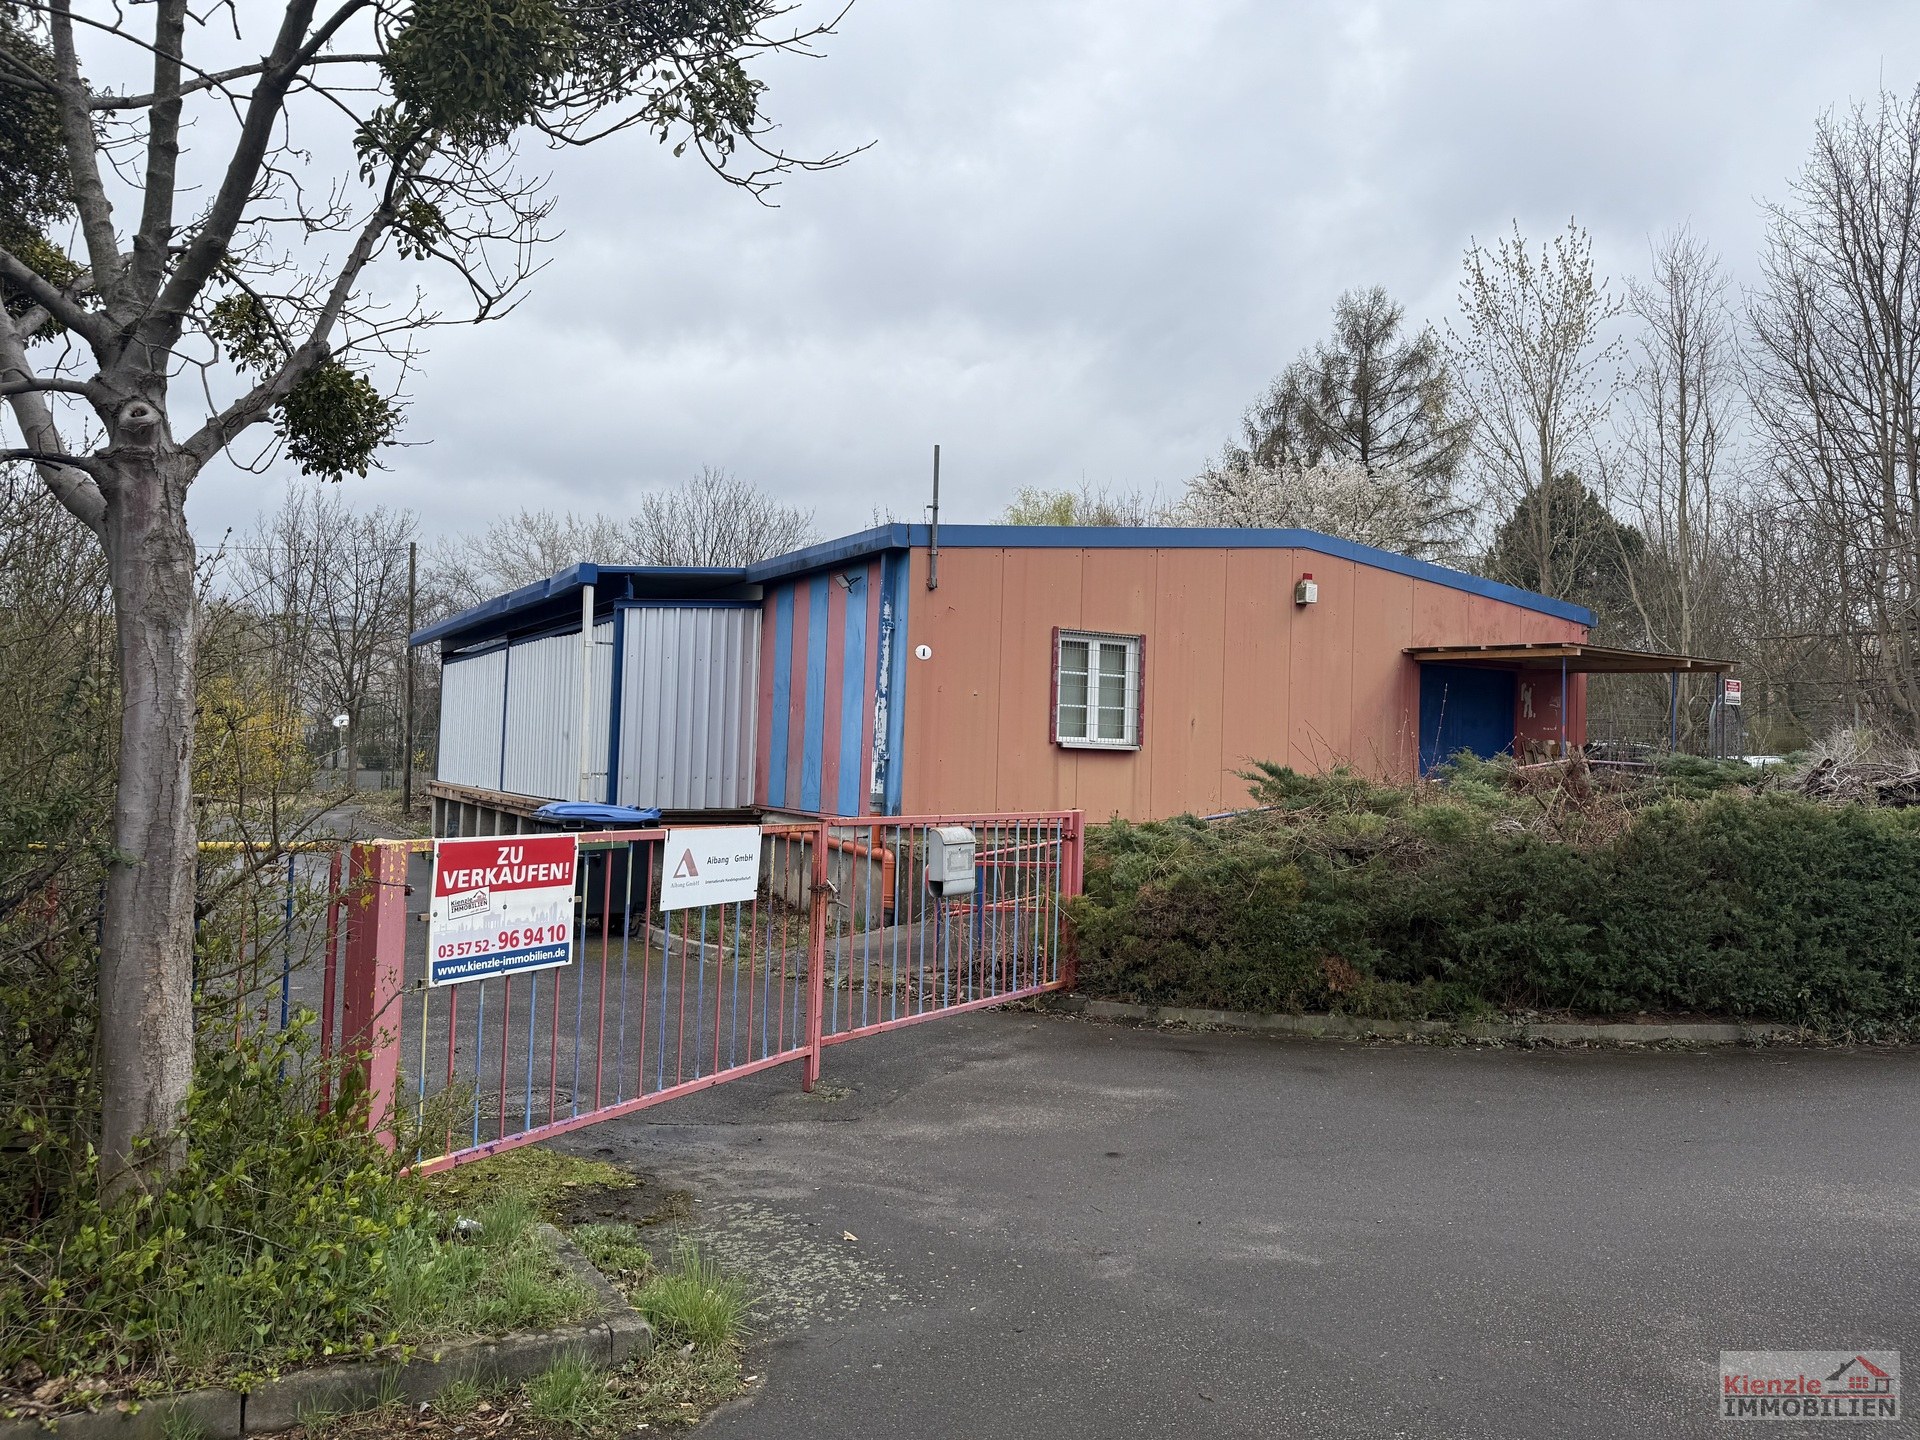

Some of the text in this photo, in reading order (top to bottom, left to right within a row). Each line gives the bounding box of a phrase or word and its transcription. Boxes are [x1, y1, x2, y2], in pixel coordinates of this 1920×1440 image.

[497, 845, 524, 865] ZU
[707, 854, 753, 865] Aibang GmbH
[442, 862, 570, 889] VERKAUFEN!
[451, 896, 473, 906] Kienzle
[451, 900, 488, 913] IMMOBILIEN
[438, 943, 455, 958] 03
[457, 941, 473, 956] 57
[474, 939, 490, 953] 52
[498, 929, 520, 950] 96
[523, 926, 544, 946] 94
[547, 923, 566, 942] 10
[437, 948, 566, 976] www.kienzle-immobilien.de
